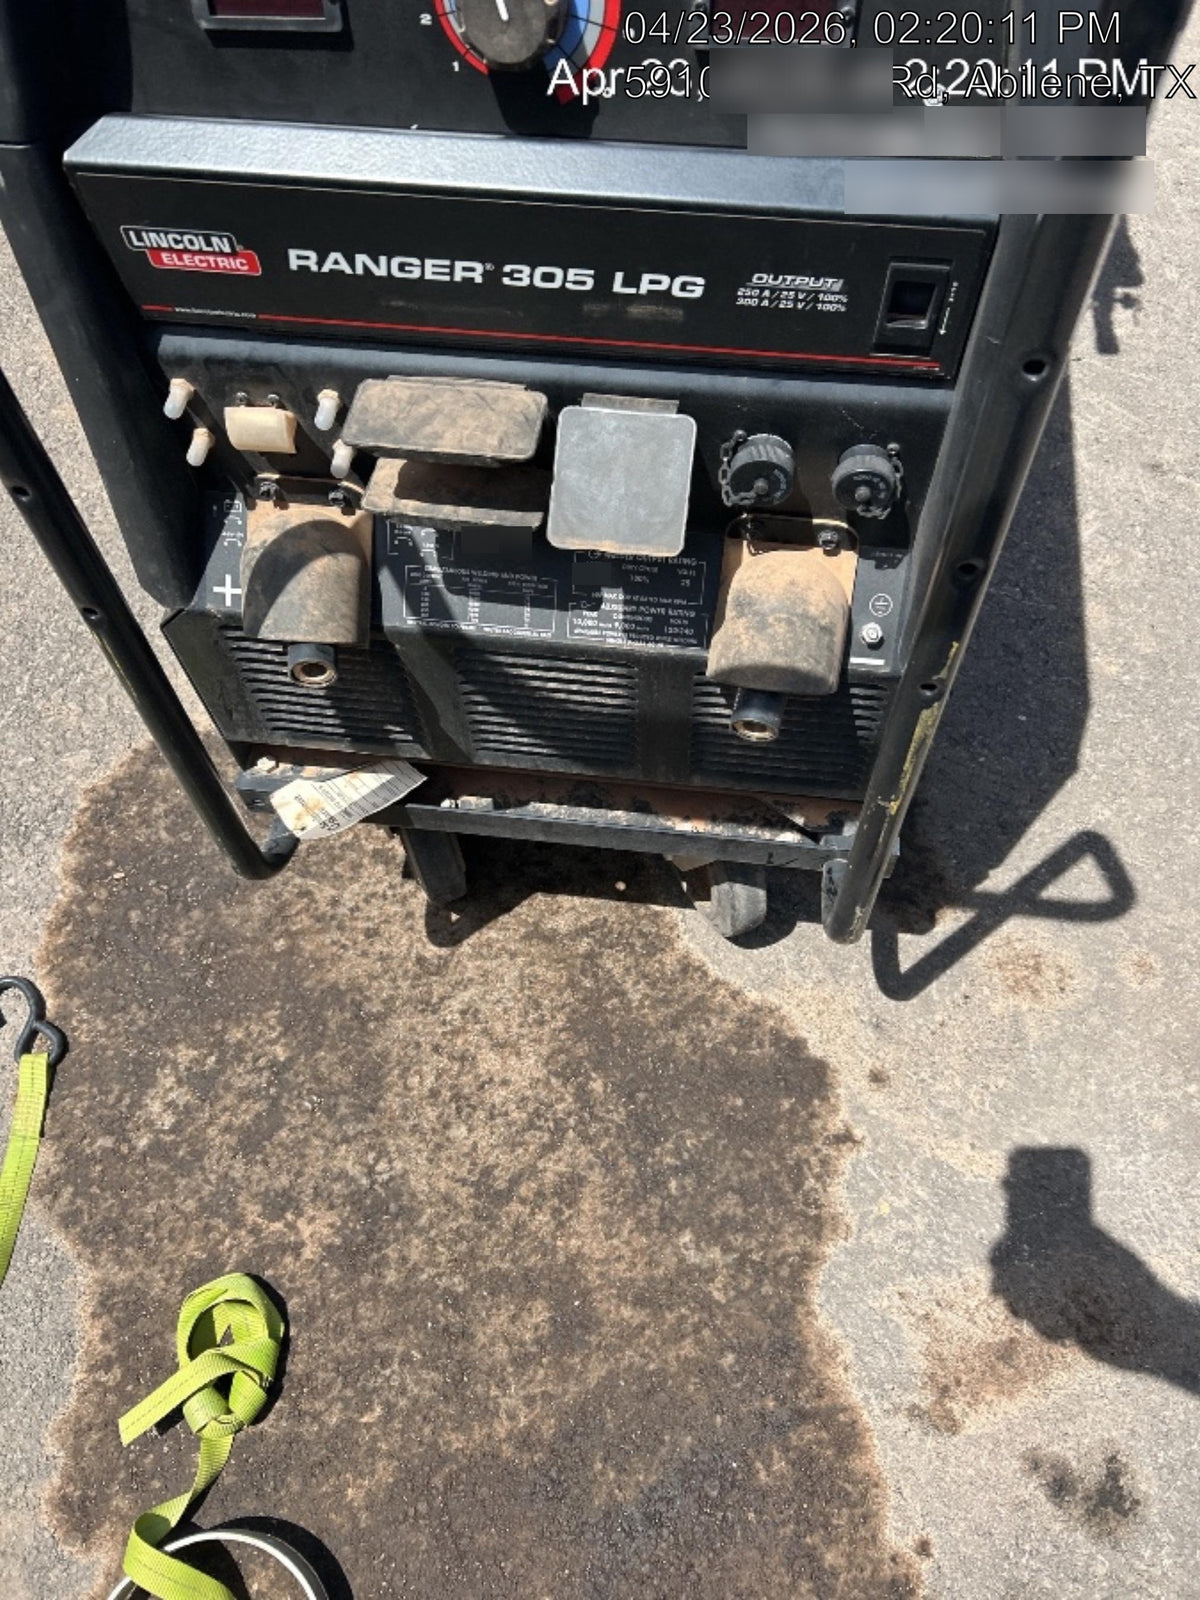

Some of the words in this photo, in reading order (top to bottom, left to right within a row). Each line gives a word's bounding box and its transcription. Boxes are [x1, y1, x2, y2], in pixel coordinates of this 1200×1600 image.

[419, 13, 433, 26] 2
[452, 61, 460, 73] 1
[128, 230, 232, 254] LINCOLN
[160, 251, 250, 271] ELECTRIC
[502, 264, 596, 292] 305
[612, 271, 706, 299] LPG
[751, 272, 839, 289] OUTPUT
[761, 289, 770, 298] A
[780, 290, 796, 300] 25
[797, 291, 807, 300] V
[760, 299, 769, 307] A
[778, 300, 794, 309] 25
[796, 301, 806, 310] V
